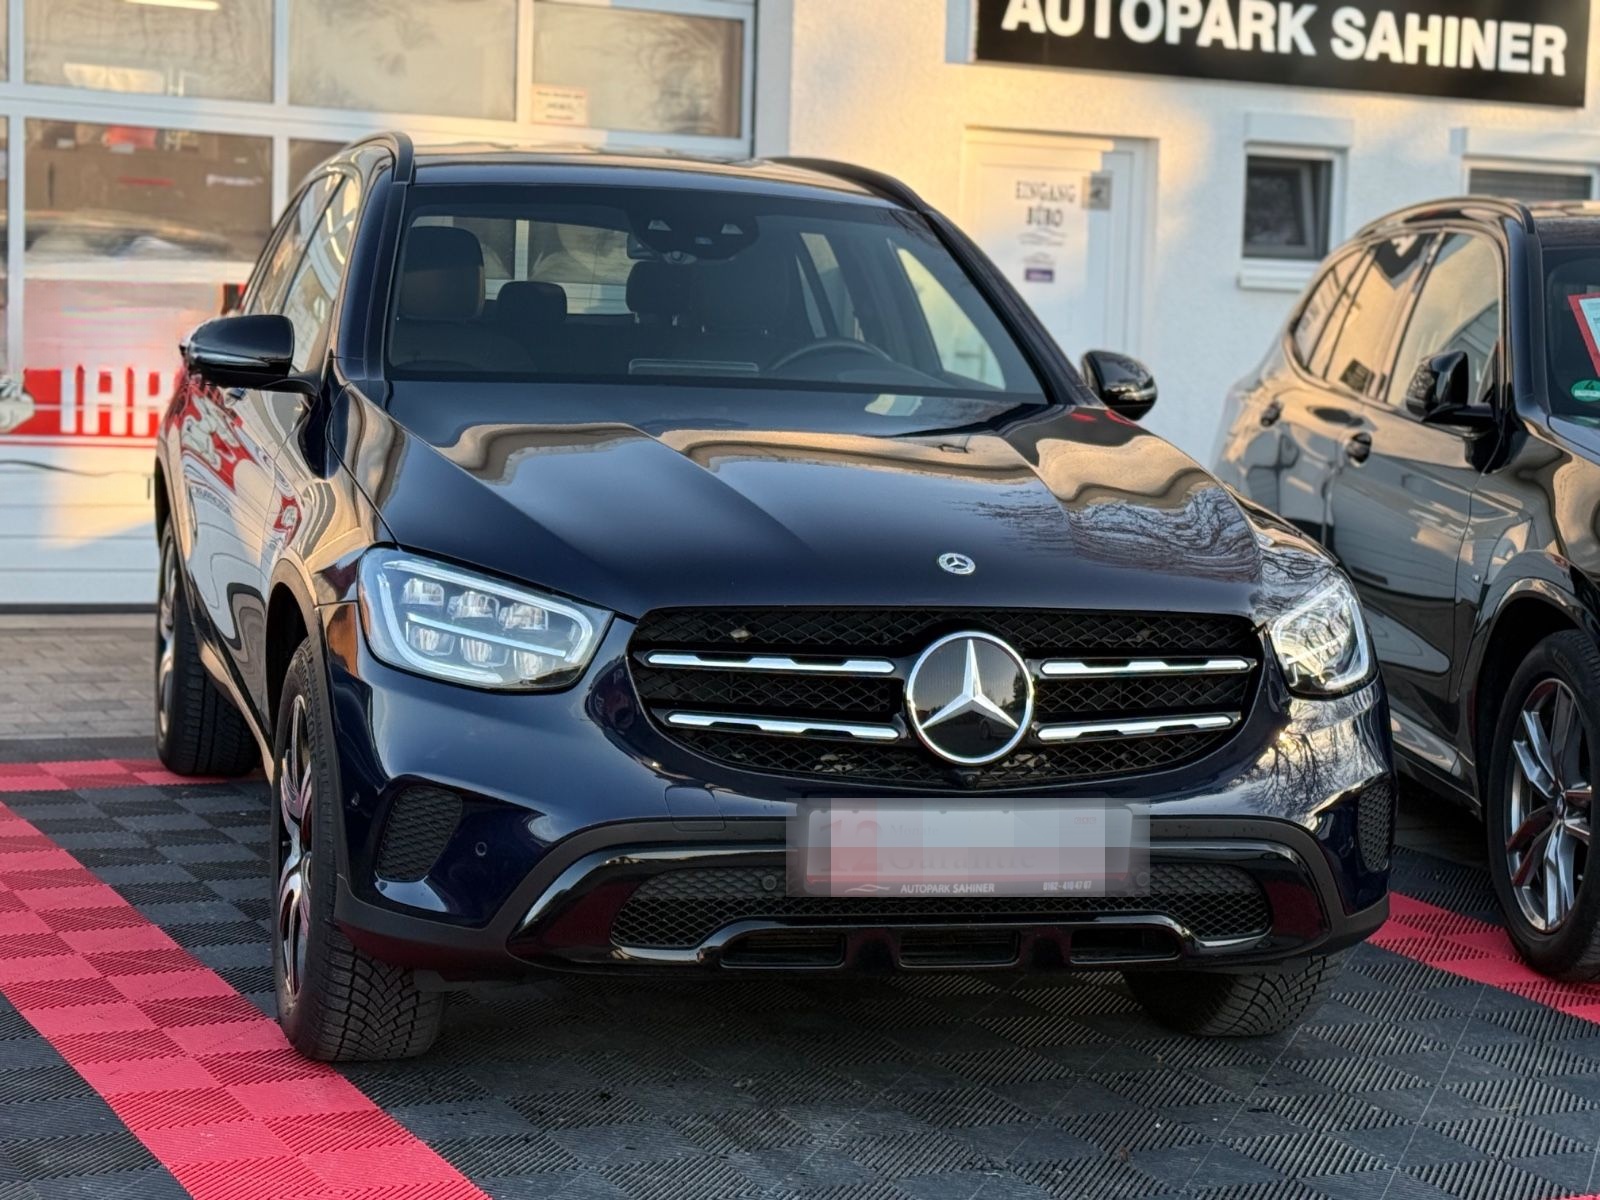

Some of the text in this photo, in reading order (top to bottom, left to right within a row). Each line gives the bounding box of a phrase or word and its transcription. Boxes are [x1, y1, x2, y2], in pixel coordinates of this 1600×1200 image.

[1001, 0, 1568, 76] AUTOPARK SAHINER
[900, 883, 995, 894] AUTOPARK SAHINER
